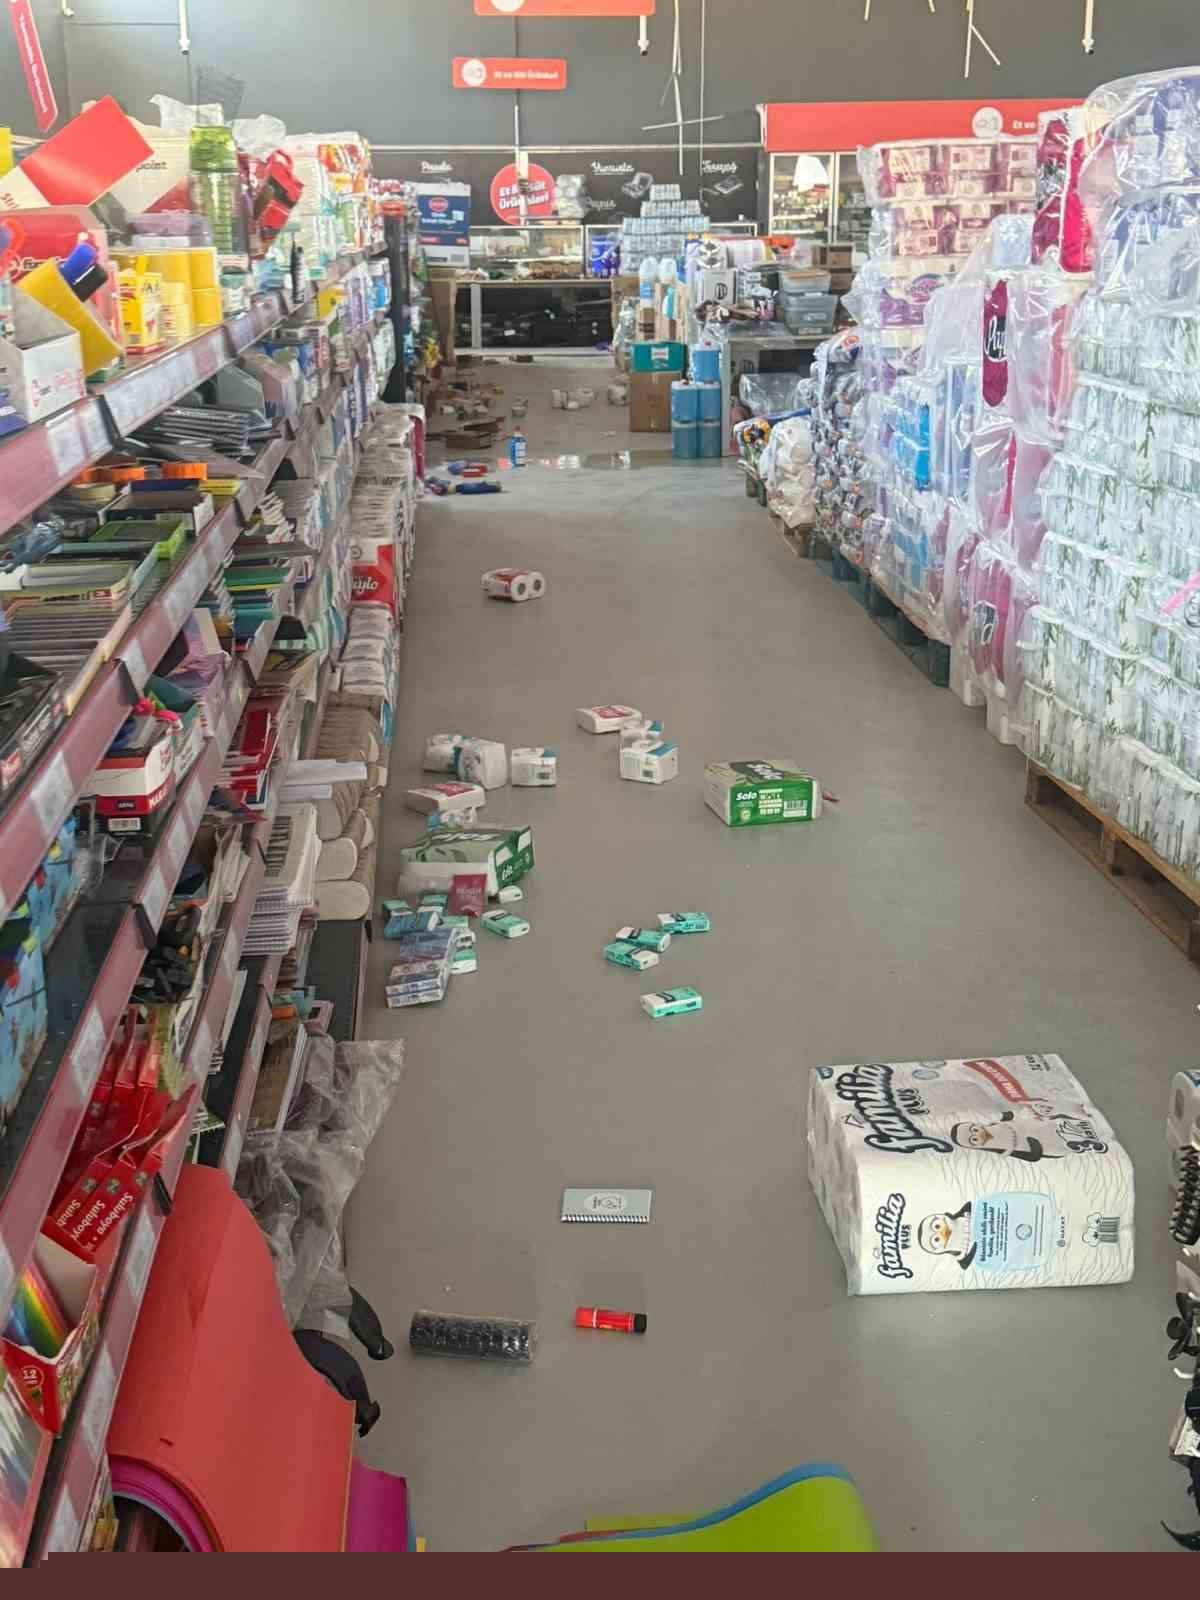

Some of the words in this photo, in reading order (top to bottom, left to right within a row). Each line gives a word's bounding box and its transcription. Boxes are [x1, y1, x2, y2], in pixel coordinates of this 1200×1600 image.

[735, 791, 758, 801] Solo
[835, 1064, 953, 1153] familia
[896, 1087, 930, 1116] PLUS
[97, 1192, 134, 1236] Suluboya
[876, 1192, 914, 1279] familia
[901, 1223, 913, 1250] PLUS
